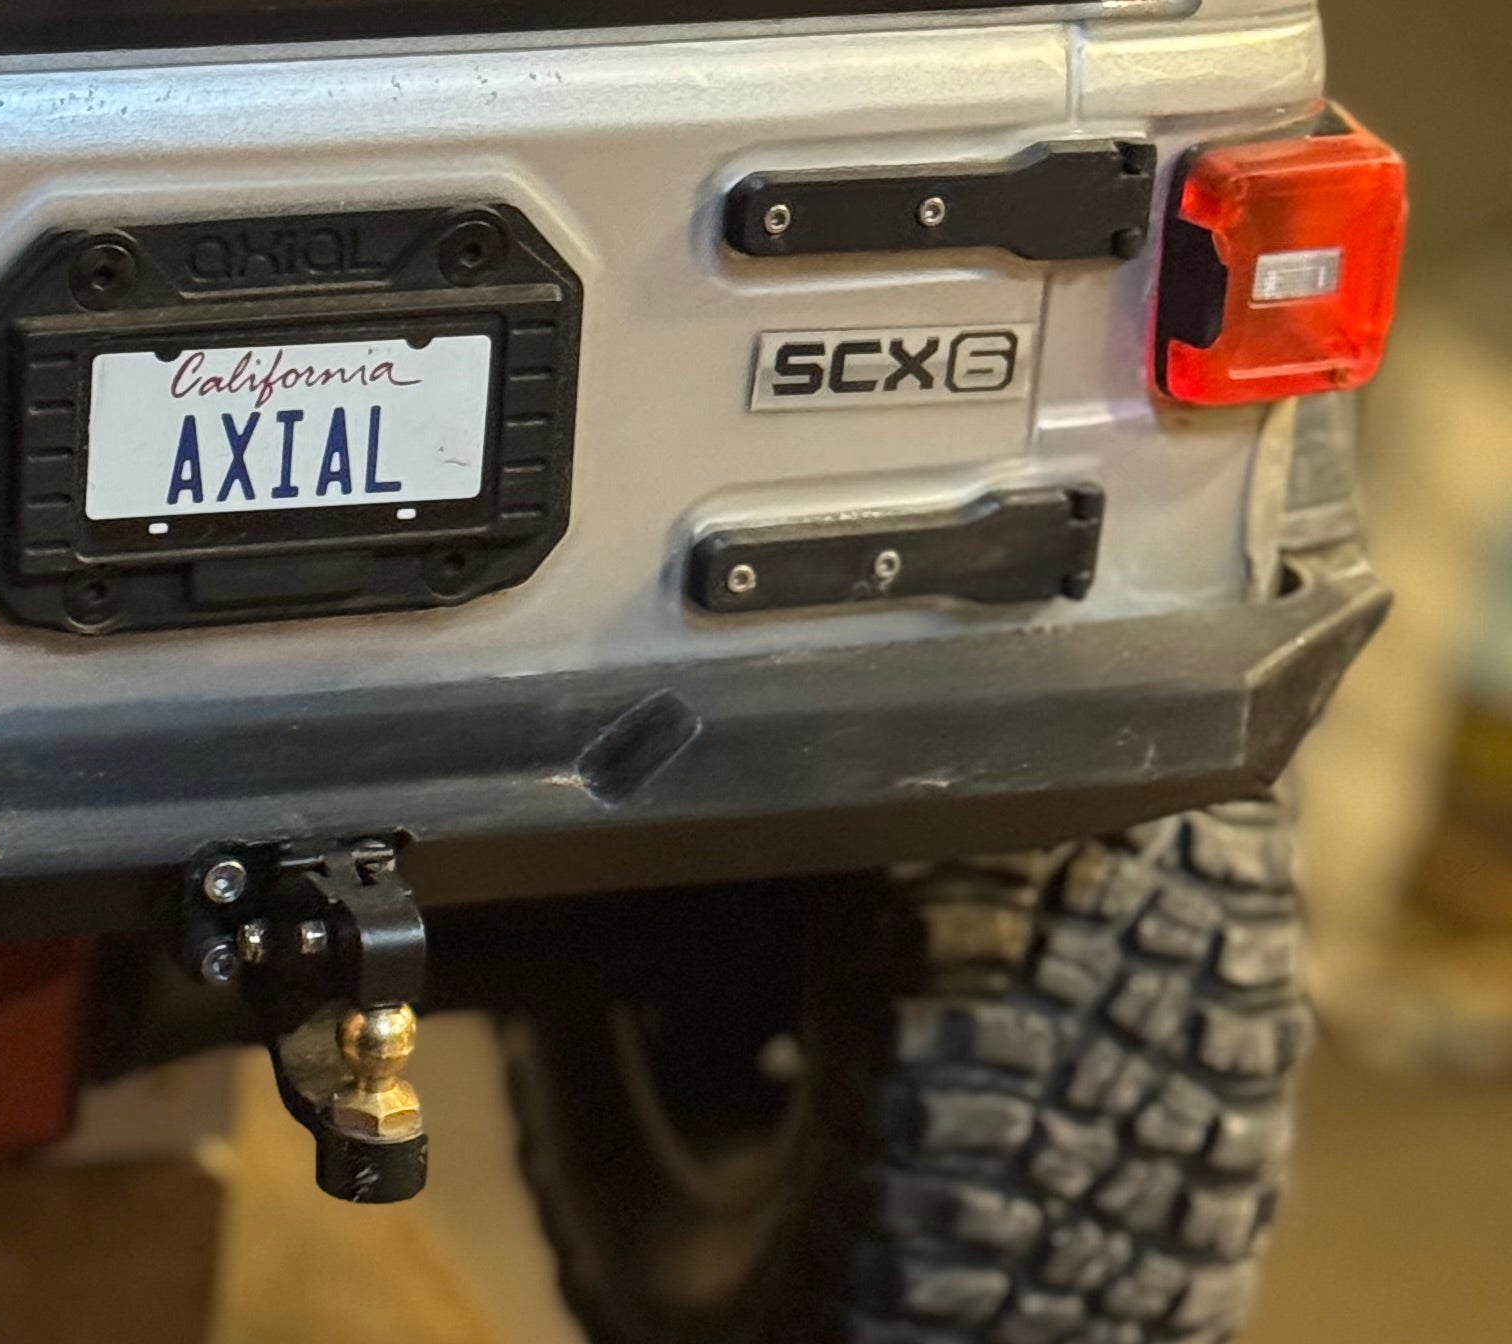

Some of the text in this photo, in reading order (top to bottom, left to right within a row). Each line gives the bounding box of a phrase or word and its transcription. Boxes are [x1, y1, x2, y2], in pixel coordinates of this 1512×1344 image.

[170, 349, 423, 408] California
[772, 330, 1018, 397] SCX6
[167, 406, 402, 505] AXIAL
